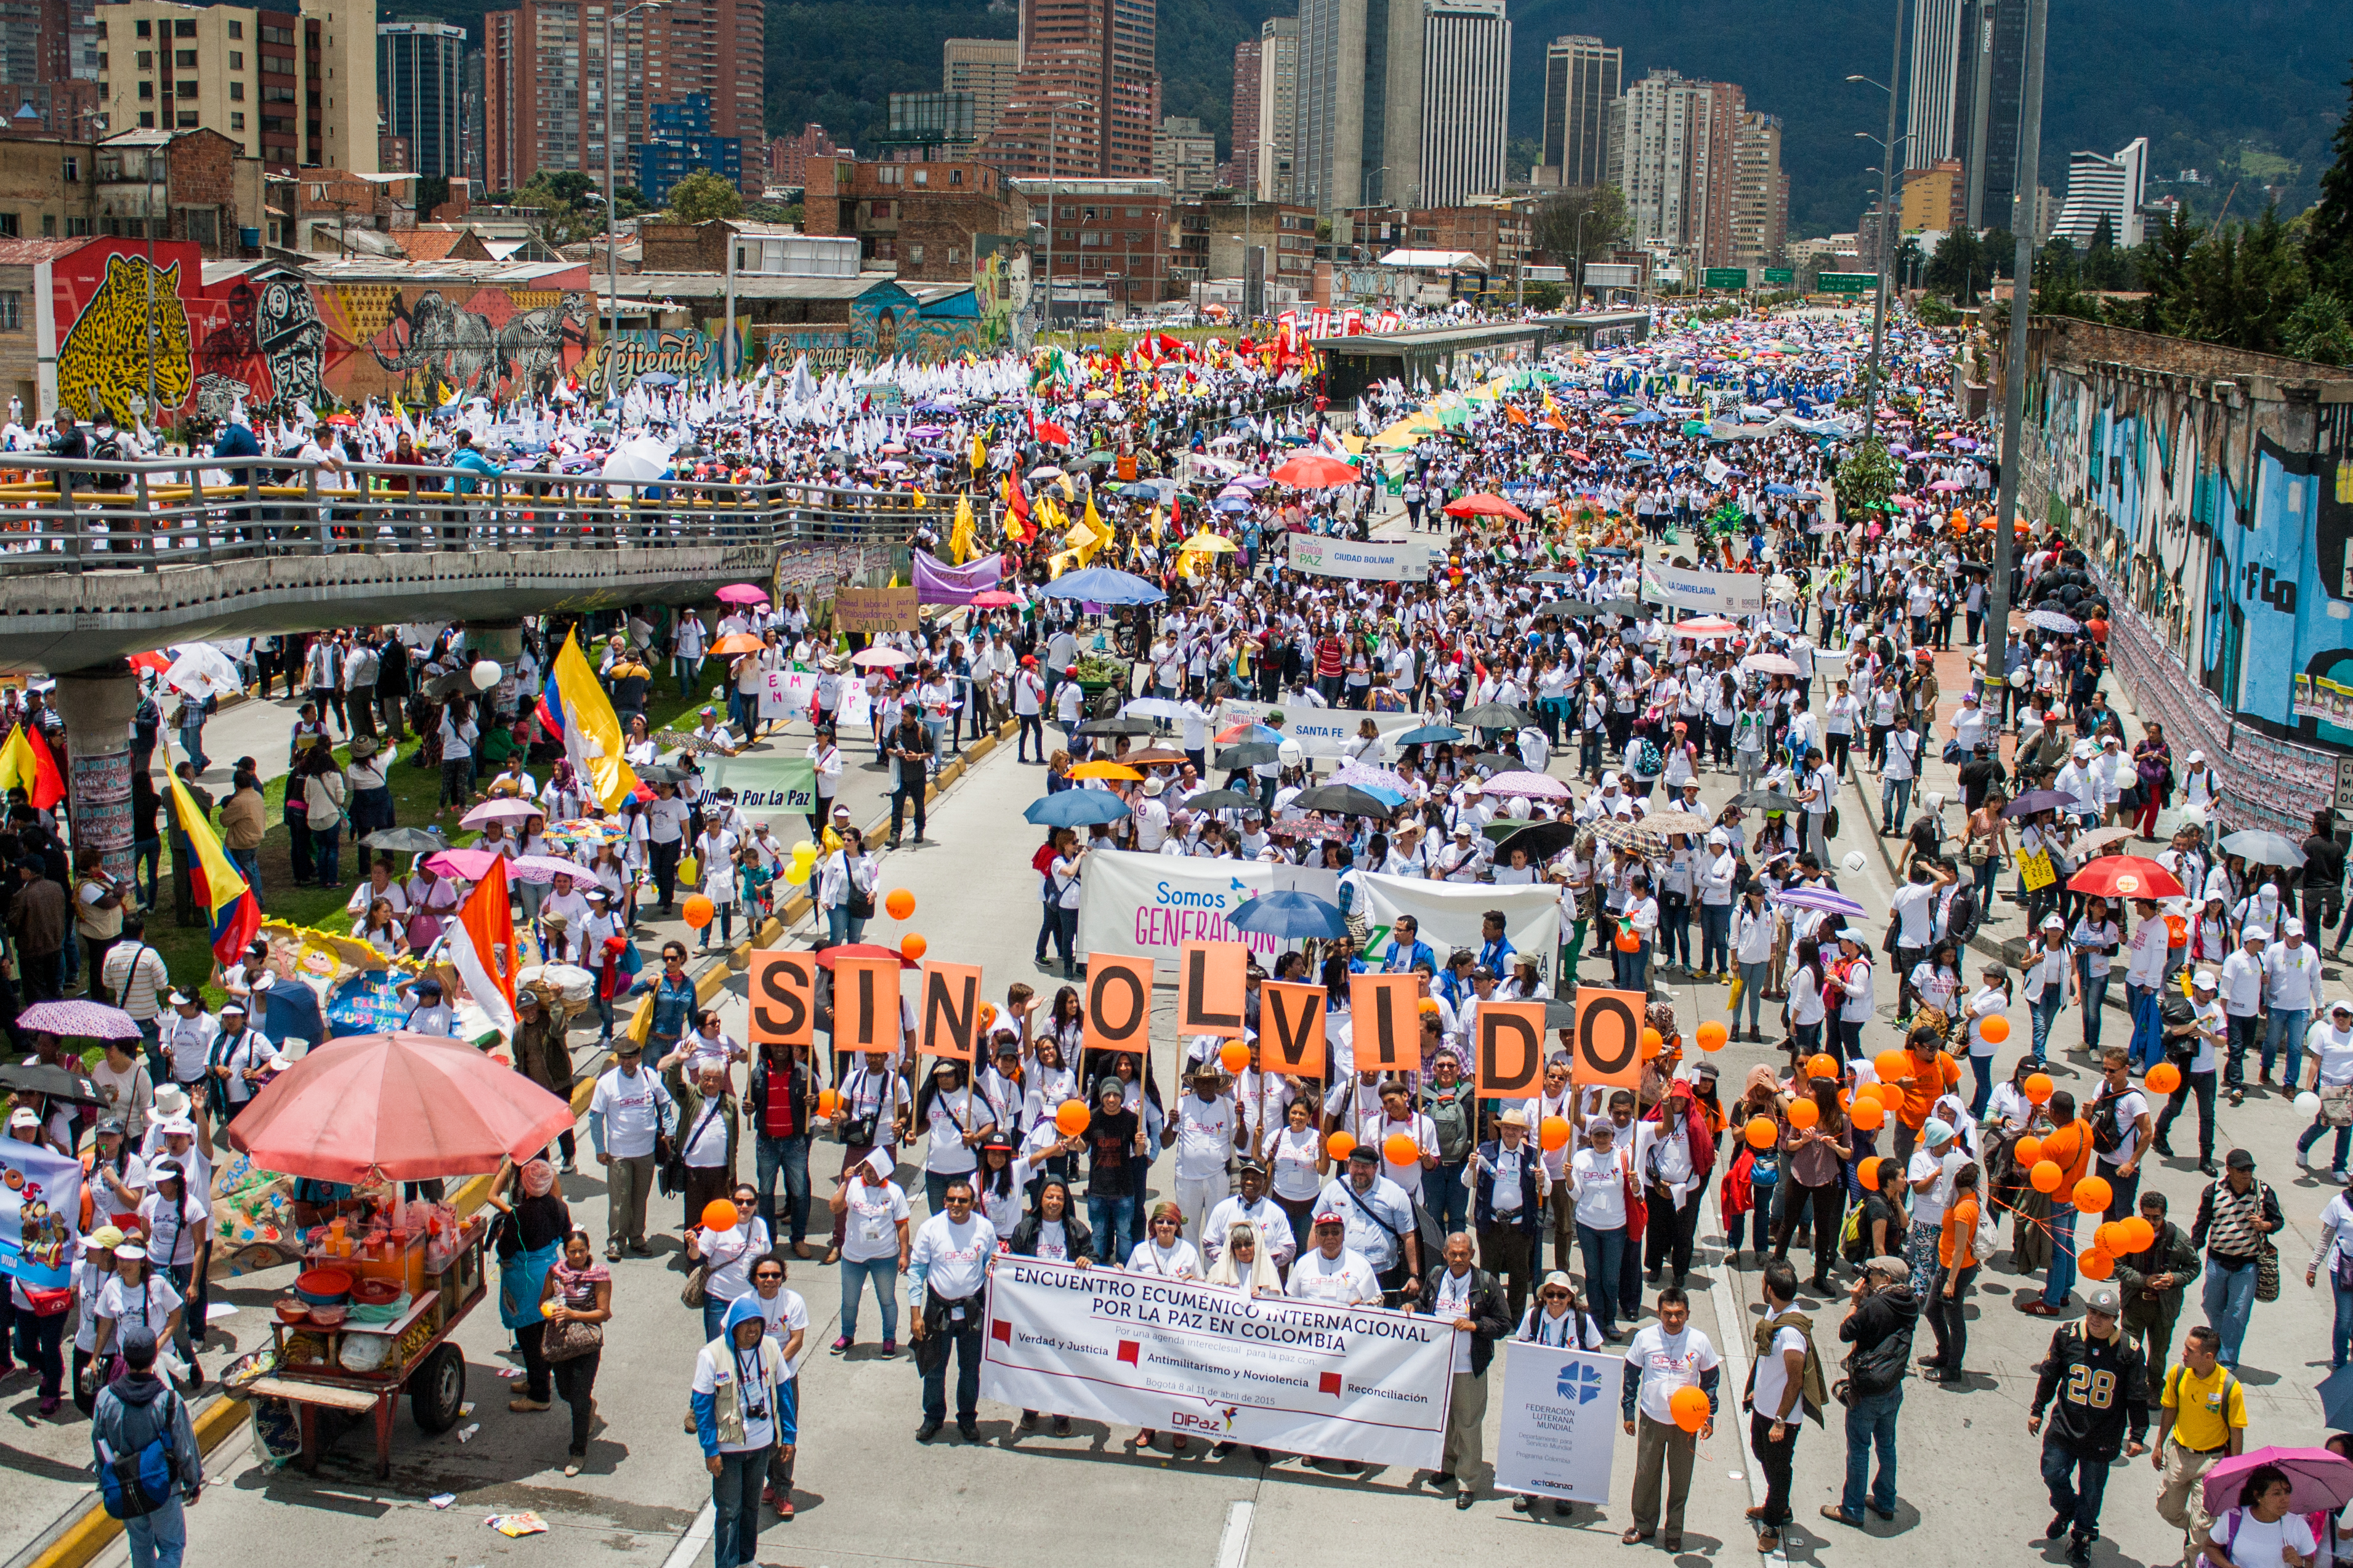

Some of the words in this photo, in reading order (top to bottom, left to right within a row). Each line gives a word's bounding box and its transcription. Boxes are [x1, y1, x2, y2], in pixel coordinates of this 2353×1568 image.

[1984, 20, 1992, 53] FONADE
[1126, 84, 1148, 94] VENTAS
[769, 336, 872, 372] Esperanza
[588, 332, 711, 396] Tejiendo
[1295, 544, 1323, 556] GENERACIÓN
[1299, 553, 1322, 566] PAZ
[1334, 553, 1362, 563] CIUDAD
[1364, 555, 1394, 565] BOLÍVAR
[1644, 581, 1661, 595] PAZ
[1668, 581, 1675, 590] LA
[1676, 582, 1716, 595] CANDELARIA
[864, 598, 889, 608] laboral
[897, 599, 914, 610] para
[844, 608, 892, 622] trabajadores
[897, 609, 908, 619] de
[846, 620, 852, 629] la
[856, 619, 897, 632] SALUD
[1230, 706, 1249, 715] Somos
[1295, 725, 1328, 737] SANTA
[1331, 728, 1344, 738] FE
[741, 790, 765, 806] Por
[768, 790, 784, 806] La
[787, 790, 811, 806] Paz
[2043, 864, 2051, 877] 730
[1156, 881, 1226, 909] Somos
[754, 960, 977, 1051] SIN
[1089, 950, 1638, 1091] OLVIDO
[1583, 1171, 1610, 1180] DiPaz
[1, 1254, 18, 1269] VIDA
[945, 1250, 973, 1260] DiPaz
[1014, 1267, 1136, 1298] ENCUENTRO
[1142, 1285, 1260, 1319] ECUMÉNICO
[1265, 1308, 1431, 1343] INTERNACIONAL
[1092, 1298, 1131, 1317] POR
[1138, 1305, 1161, 1323] LA
[1168, 1310, 1202, 1330] PAZ
[1209, 1317, 1235, 1335] EN
[1241, 1322, 1346, 1352] COLOMBIA
[1018, 1333, 1055, 1347] Verdad
[1057, 1341, 1065, 1350] y
[1067, 1341, 1108, 1356] Justicia
[1115, 1325, 1133, 1335] Por
[1132, 1330, 1150, 1338] una
[1152, 1334, 1185, 1347] agenda
[1187, 1337, 1241, 1354] intereclesial
[1246, 1348, 1266, 1359] para
[1269, 1350, 1277, 1361] la
[1279, 1354, 1296, 1364] paz
[1298, 1356, 1318, 1366] con:
[1652, 1355, 1684, 1368] DiPaz
[1147, 1353, 1231, 1376] Antimilitarismo
[1233, 1370, 1240, 1379] y
[1243, 1369, 1309, 1388] Noviolencia
[1146, 1378, 1177, 1390] Bogotá
[1178, 1383, 1185, 1391] 8
[1186, 1383, 1195, 1393] al
[1196, 1385, 1205, 1394] 11
[1207, 1388, 1218, 1397] de
[1220, 1390, 1239, 1401] abril
[1241, 1393, 1253, 1402] de
[1254, 1395, 1275, 1405] 2015
[2067, 1363, 2116, 1409] 28
[1347, 1383, 1428, 1404] Reconciliación
[1525, 1403, 1575, 1416] FEDERACIÓN
[1172, 1411, 1220, 1431] DiPaz
[1532, 1413, 1574, 1425] LUTERANA
[1536, 1421, 1573, 1433] MUNDIAL
[1519, 1432, 1558, 1443] Departamento
[1559, 1437, 1572, 1445] para
[1526, 1439, 1548, 1448] Servicio
[1549, 1442, 1572, 1451] Mundial
[1516, 1450, 1543, 1461] Programa
[1544, 1455, 1570, 1465] Colombia
[1531, 1479, 1573, 1490] actalianza
